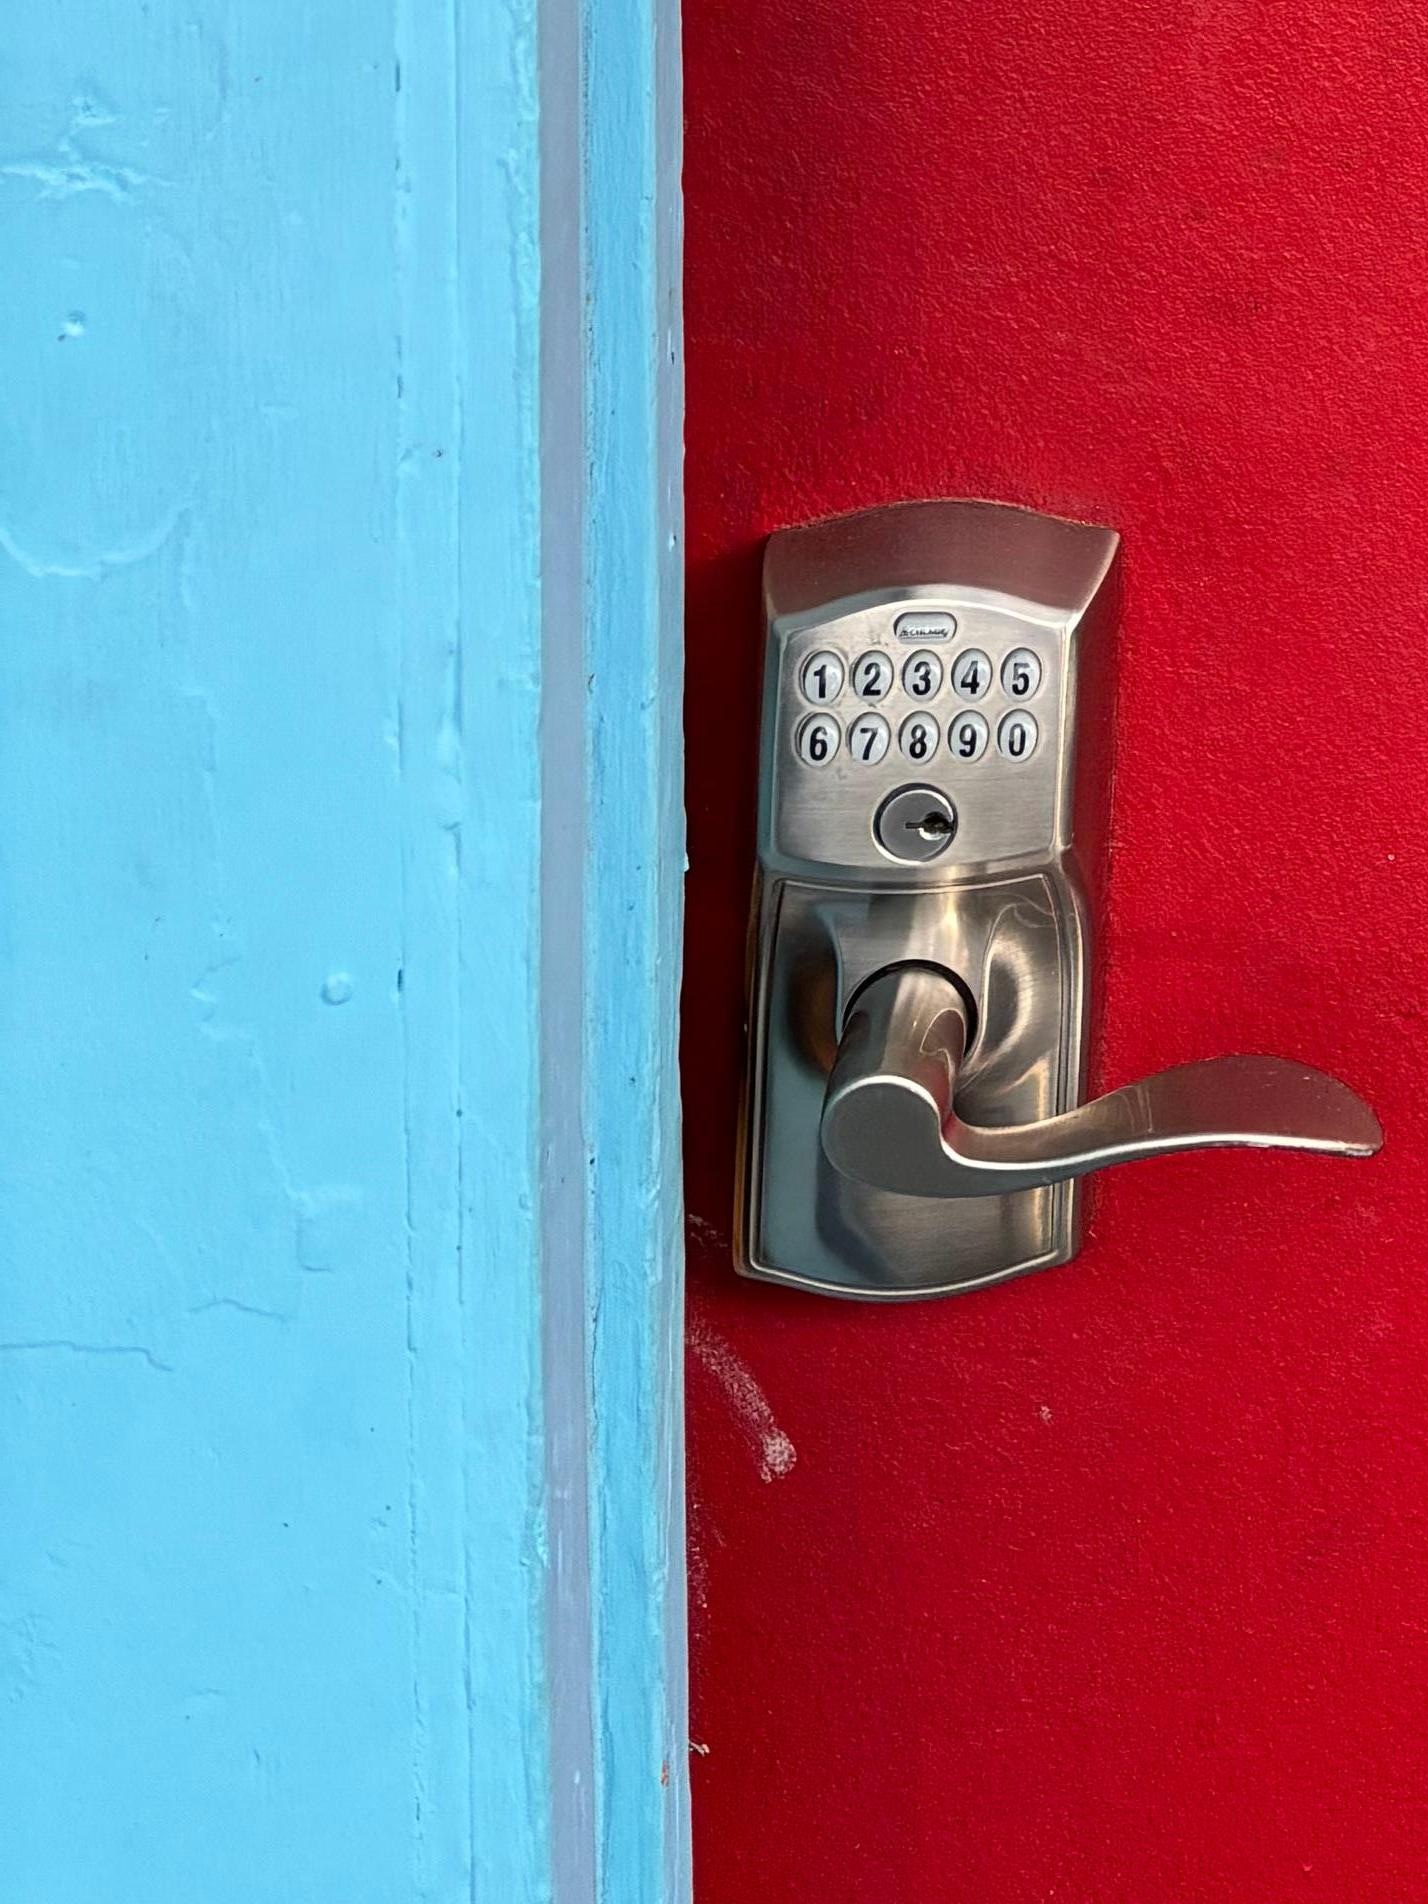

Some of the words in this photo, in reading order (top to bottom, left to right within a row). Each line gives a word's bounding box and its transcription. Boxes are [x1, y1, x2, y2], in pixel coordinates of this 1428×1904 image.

[814, 664, 827, 698] 1
[862, 662, 881, 696] 2
[912, 661, 931, 695] 3
[961, 660, 980, 694] 4
[1012, 663, 1030, 695] 5
[809, 726, 828, 761] 6
[860, 728, 879, 760] 7
[909, 724, 926, 759] 8
[959, 725, 977, 757] 9
[1009, 723, 1026, 756] 0
